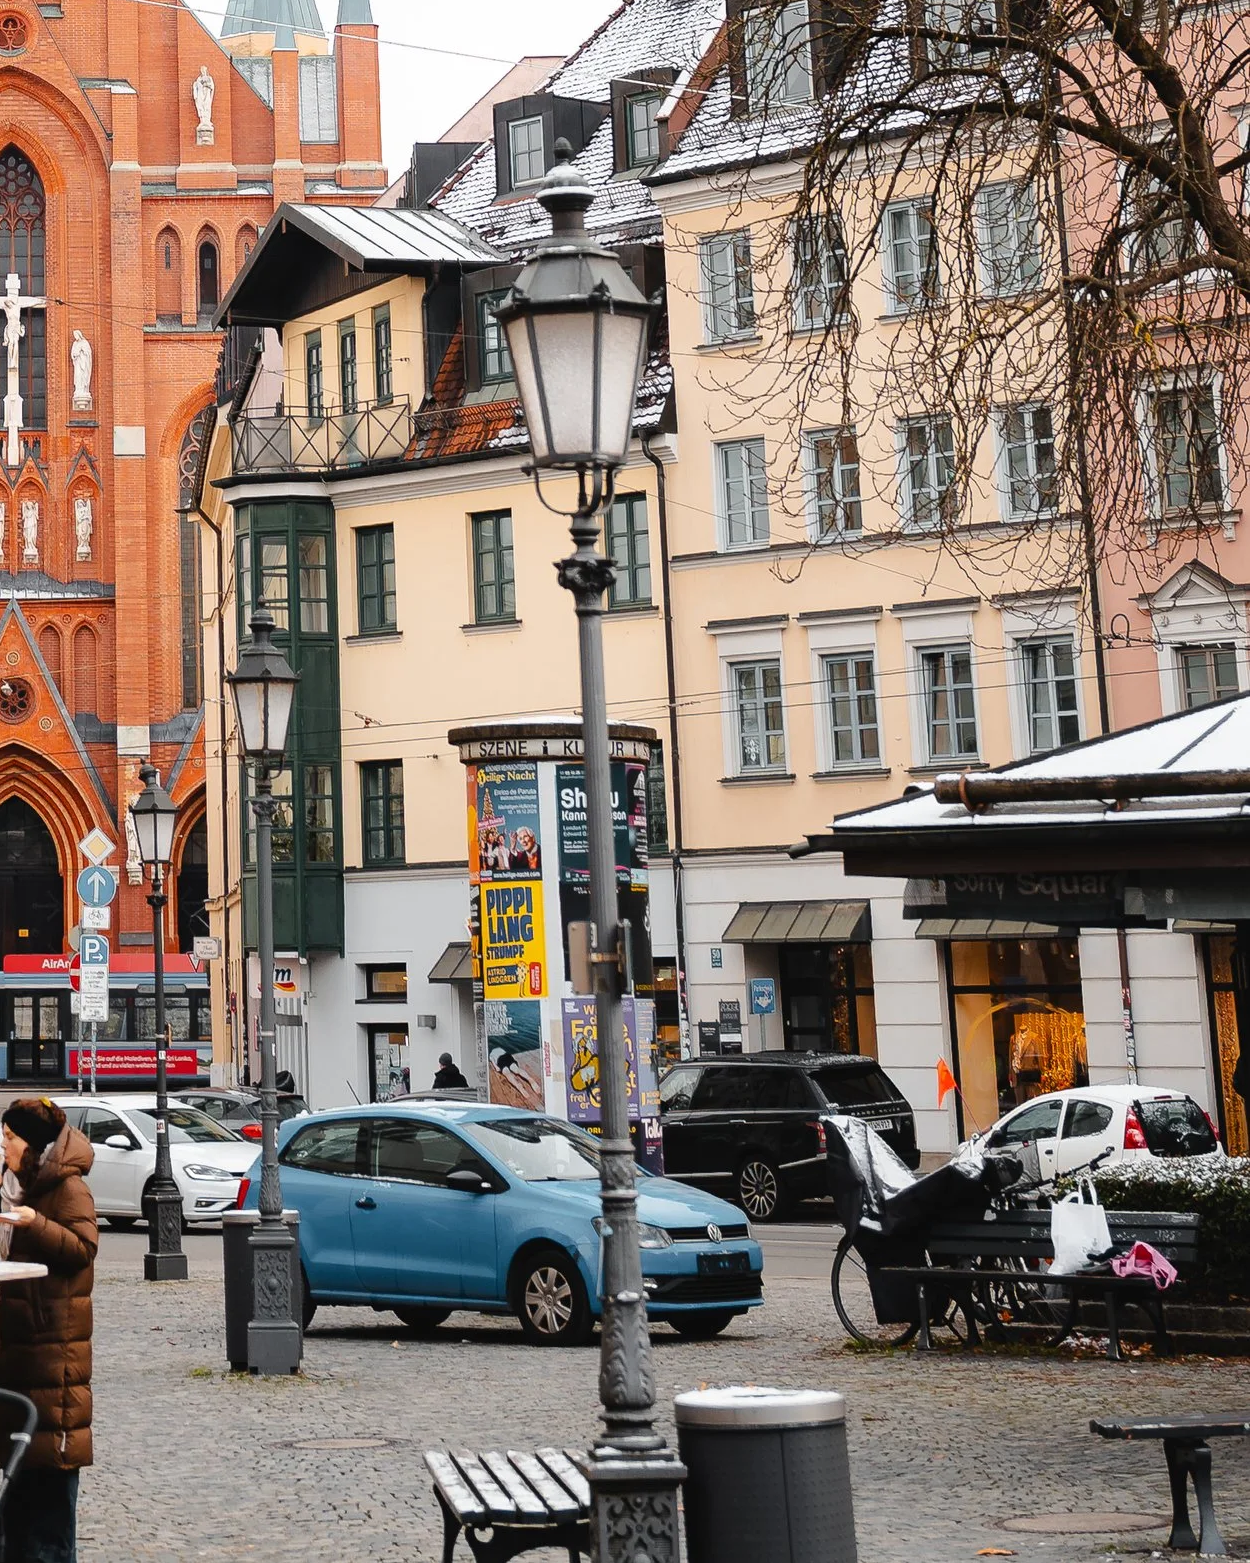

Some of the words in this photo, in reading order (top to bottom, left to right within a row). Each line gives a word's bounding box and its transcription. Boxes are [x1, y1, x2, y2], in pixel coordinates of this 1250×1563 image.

[479, 740, 527, 757] SZENE
[507, 770, 536, 781] Nacht
[560, 787, 619, 809] Shu
[486, 887, 533, 916] PIPPI
[488, 915, 534, 944] LANG
[486, 944, 524, 960] STRUMPF
[274, 968, 291, 981] m
[488, 968, 506, 976] ASTRID
[488, 975, 517, 984] LINDGREN
